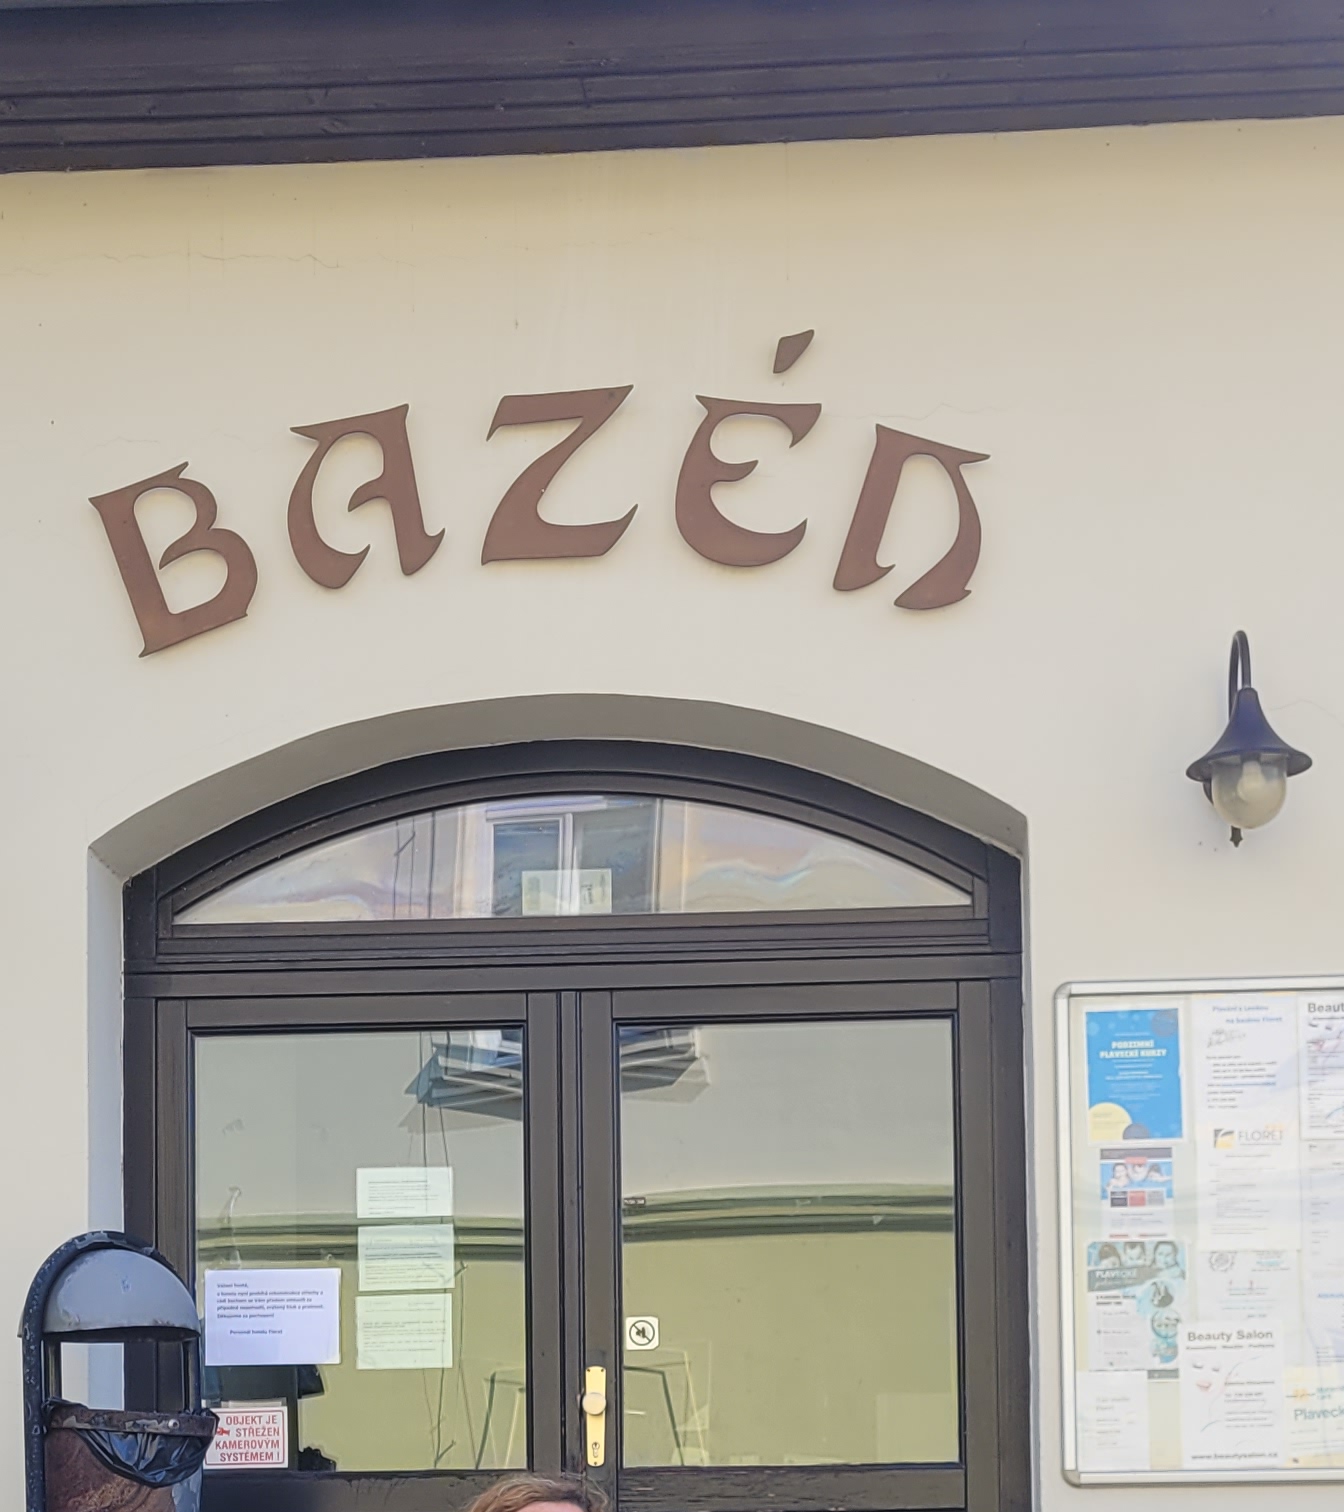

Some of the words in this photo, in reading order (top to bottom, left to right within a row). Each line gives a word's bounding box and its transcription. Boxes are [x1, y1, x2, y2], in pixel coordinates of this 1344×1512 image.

[87, 330, 990, 658] BAZÉN
[1187, 1331, 1233, 1342] Beauty
[1236, 1330, 1273, 1340] Salon
[225, 1415, 262, 1426] OBJEKT
[265, 1414, 278, 1425] JE
[235, 1425, 280, 1438] STŘEŽEN
[215, 1437, 280, 1450] KAMEROVÝM
[219, 1450, 274, 1462] SYSTÉMEM
